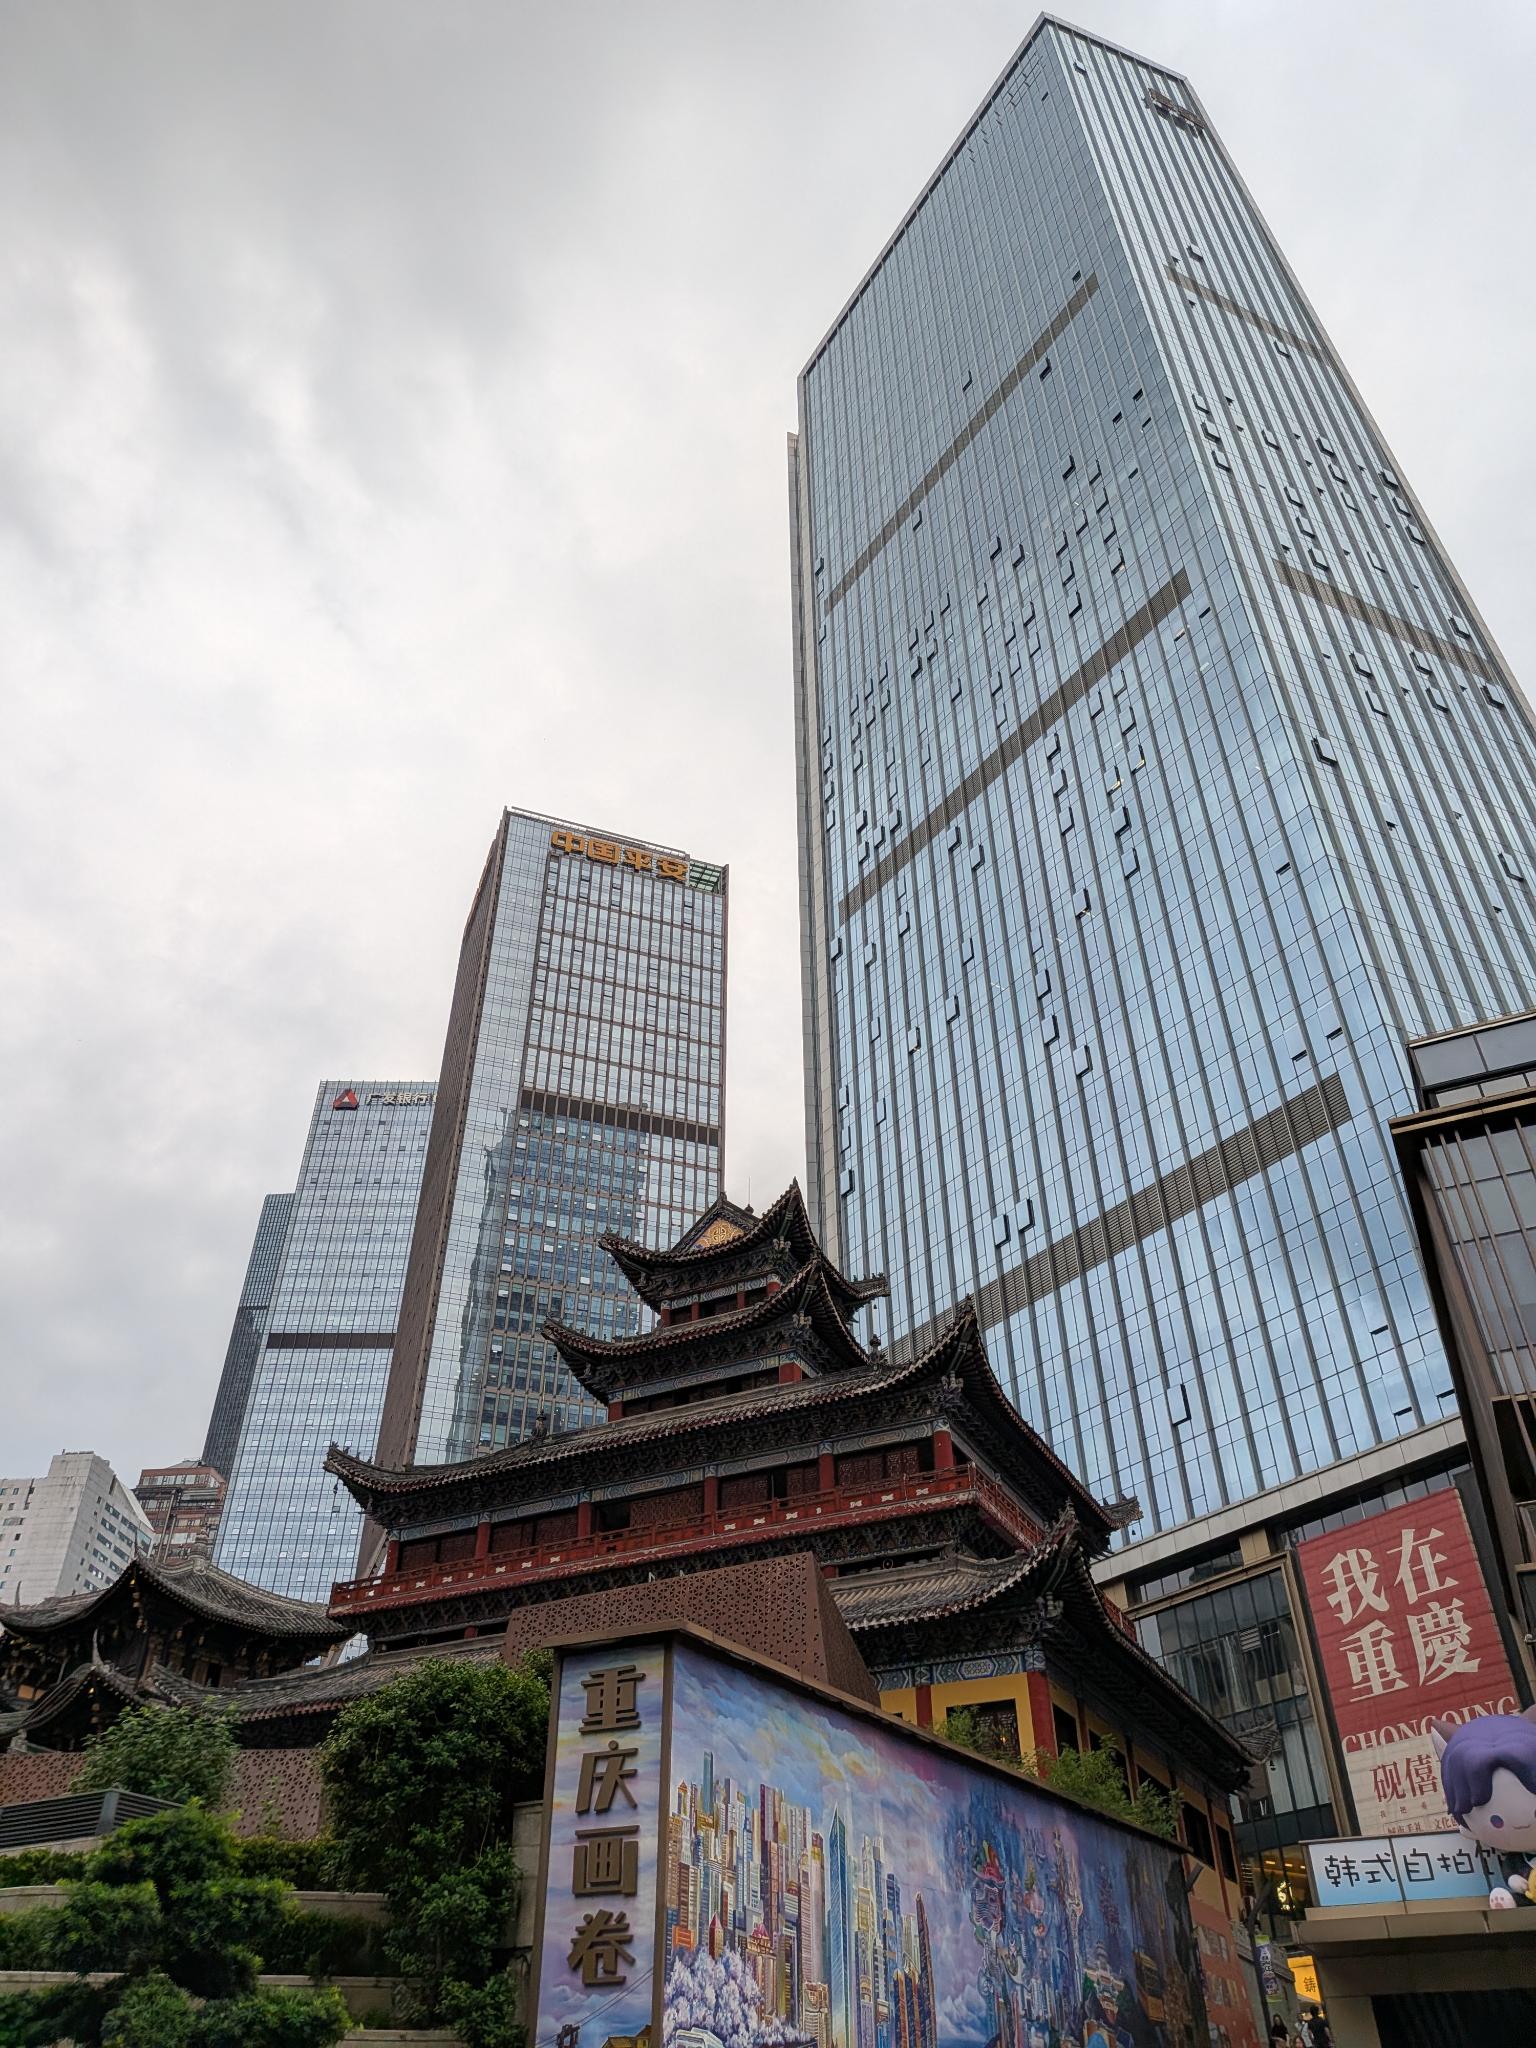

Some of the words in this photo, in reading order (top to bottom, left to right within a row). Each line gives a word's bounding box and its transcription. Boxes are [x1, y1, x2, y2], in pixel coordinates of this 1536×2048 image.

[551, 831, 688, 881] 中国平安
[366, 1092, 429, 1106] 广发银行
[1321, 1527, 1459, 1625] 我在
[1340, 1598, 1481, 1703] 重慶
[567, 1664, 646, 1986] 重庆画卷
